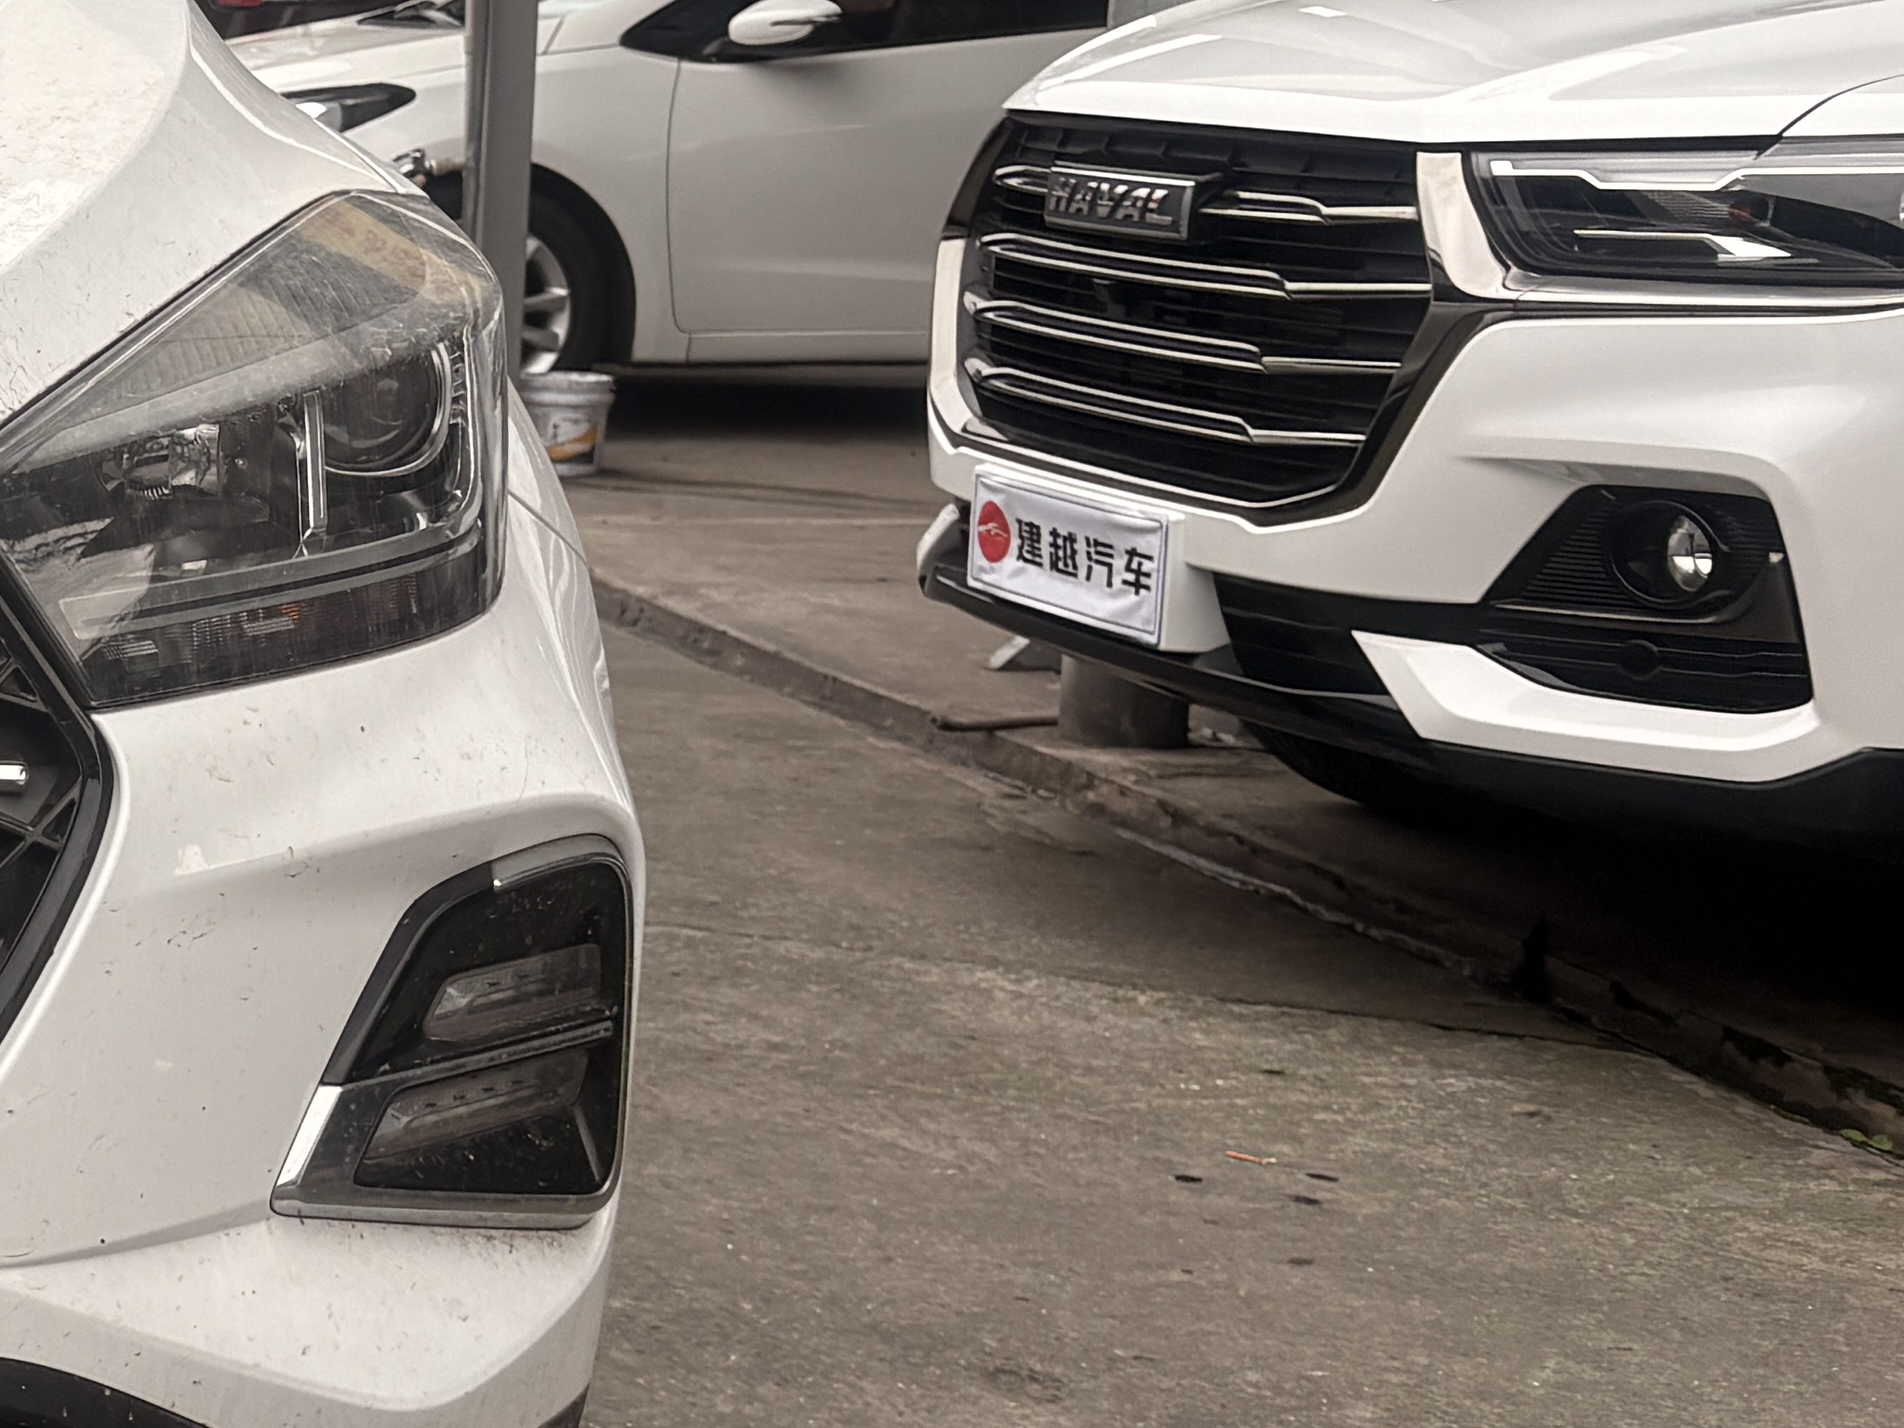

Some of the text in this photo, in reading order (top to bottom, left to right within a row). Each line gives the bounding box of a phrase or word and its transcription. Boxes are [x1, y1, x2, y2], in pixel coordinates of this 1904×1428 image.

[1049, 176, 1173, 226] HAVAL
[1015, 517, 1155, 597] 建越汽车
